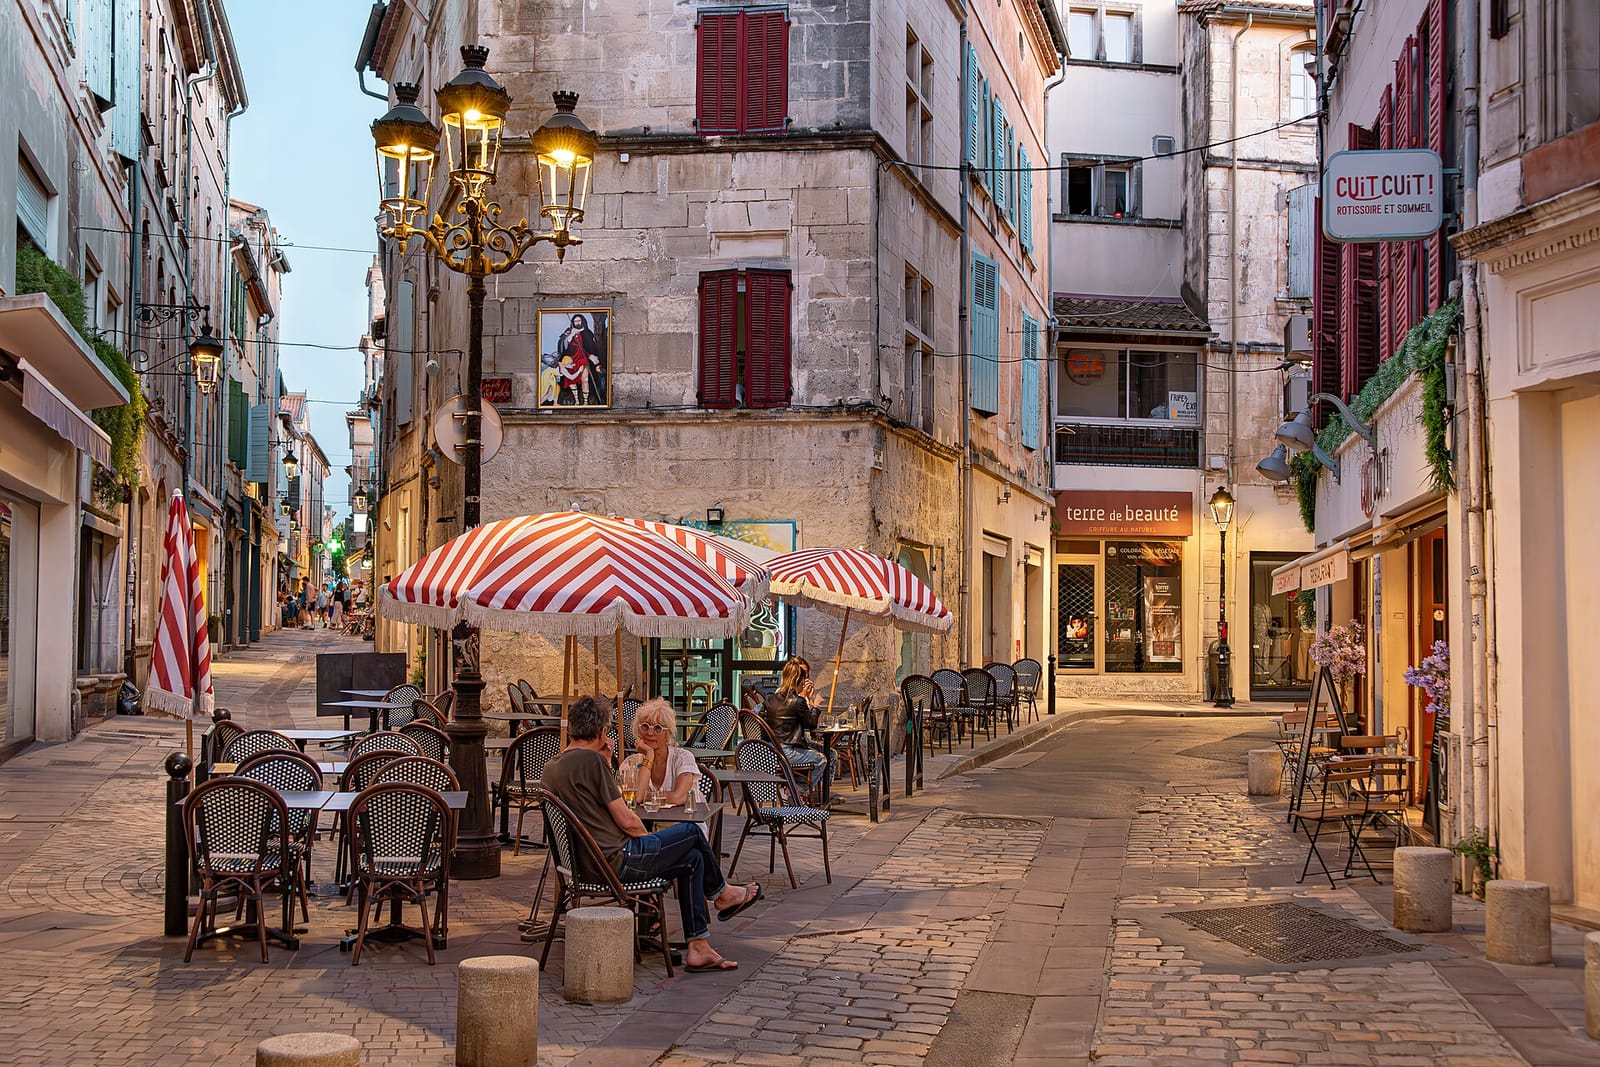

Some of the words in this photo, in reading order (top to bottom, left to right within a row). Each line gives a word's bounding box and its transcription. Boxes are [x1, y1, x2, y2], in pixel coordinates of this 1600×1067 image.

[1336, 204, 1382, 215] ROTISSOIRE
[1384, 204, 1394, 214] ET
[1397, 203, 1433, 214] SOMMEIL
[1066, 506, 1105, 521] terre
[1109, 509, 1122, 521] de
[1125, 504, 1179, 522] beauté
